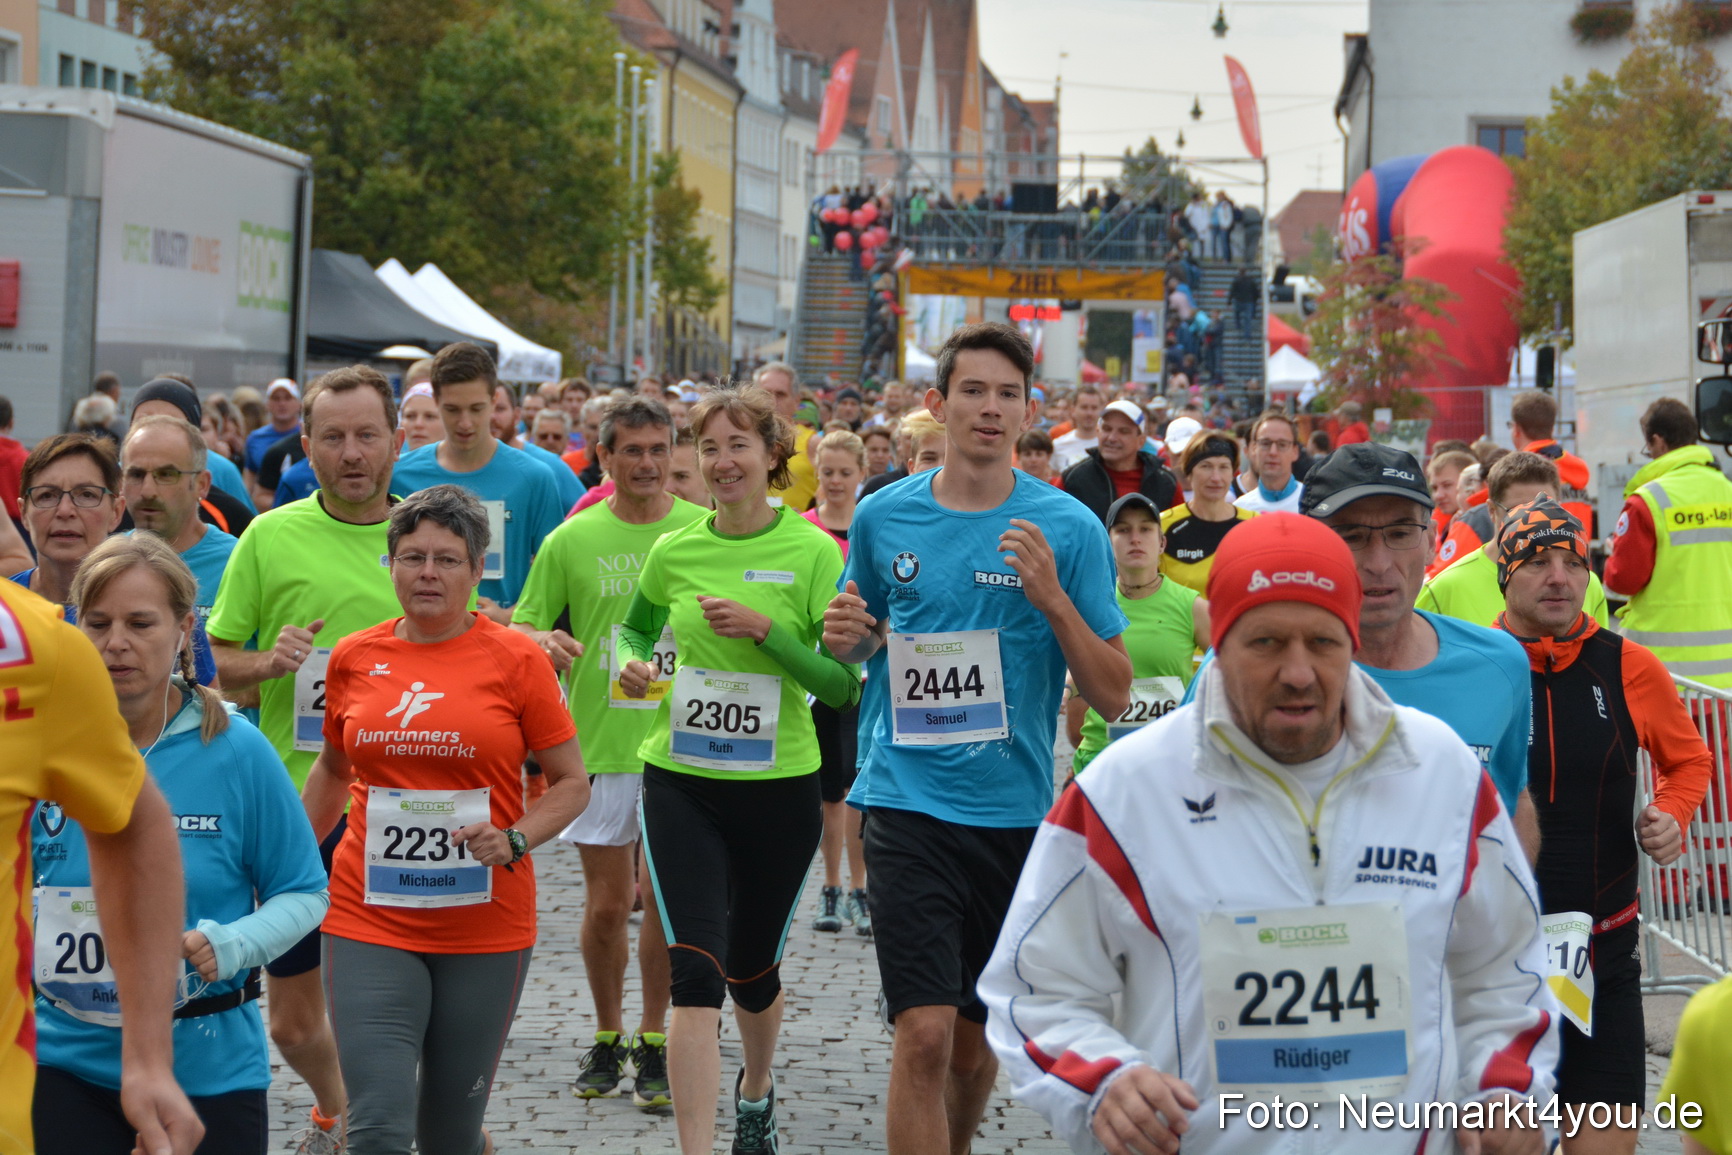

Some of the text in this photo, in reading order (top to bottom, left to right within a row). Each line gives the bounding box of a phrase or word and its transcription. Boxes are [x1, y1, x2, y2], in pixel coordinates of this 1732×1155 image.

[1009, 271, 1064, 295] ZIEL
[597, 553, 650, 575] NOV
[1176, 549, 1205, 560] Birgit
[1271, 570, 1335, 592] odlo
[924, 642, 964, 654] BOCK
[905, 664, 985, 701] 2444
[686, 699, 761, 734] 2305
[925, 711, 967, 725] Samuel
[355, 728, 460, 747] funrunners
[709, 741, 733, 753] Ruth
[385, 743, 476, 758] neumarkt
[412, 801, 455, 811] BOCK
[1358, 847, 1437, 876] JURA
[399, 873, 456, 887] Michaela
[1355, 873, 1437, 890] SPORT-Service
[1279, 923, 1348, 943] BOCK
[54, 931, 106, 974] 20
[1547, 941, 1588, 979] 10
[92, 987, 119, 1003] Ank
[1234, 963, 1380, 1026] 2244
[1273, 1047, 1351, 1071] Rüdiger
